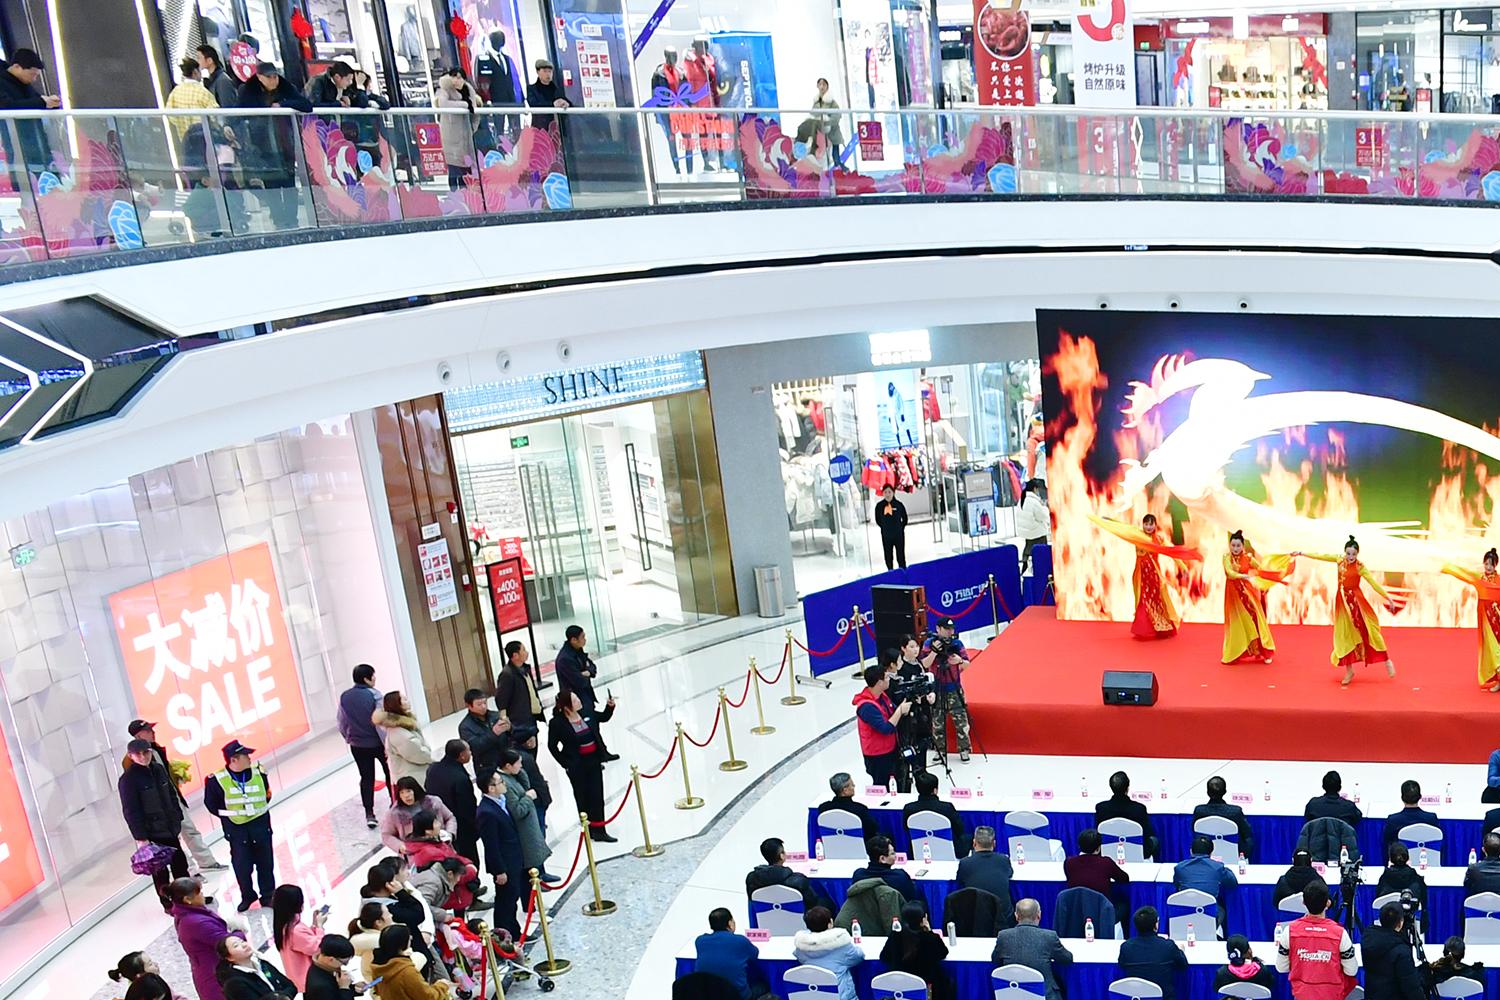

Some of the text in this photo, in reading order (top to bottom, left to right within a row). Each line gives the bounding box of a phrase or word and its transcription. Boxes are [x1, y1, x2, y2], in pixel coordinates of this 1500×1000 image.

[1083, 62, 1126, 76] 烤炉升级
[1084, 77, 1126, 91] 自然原味
[542, 366, 626, 405] SHINE
[132, 578, 276, 696] 大减价
[165, 655, 282, 757] SALE
